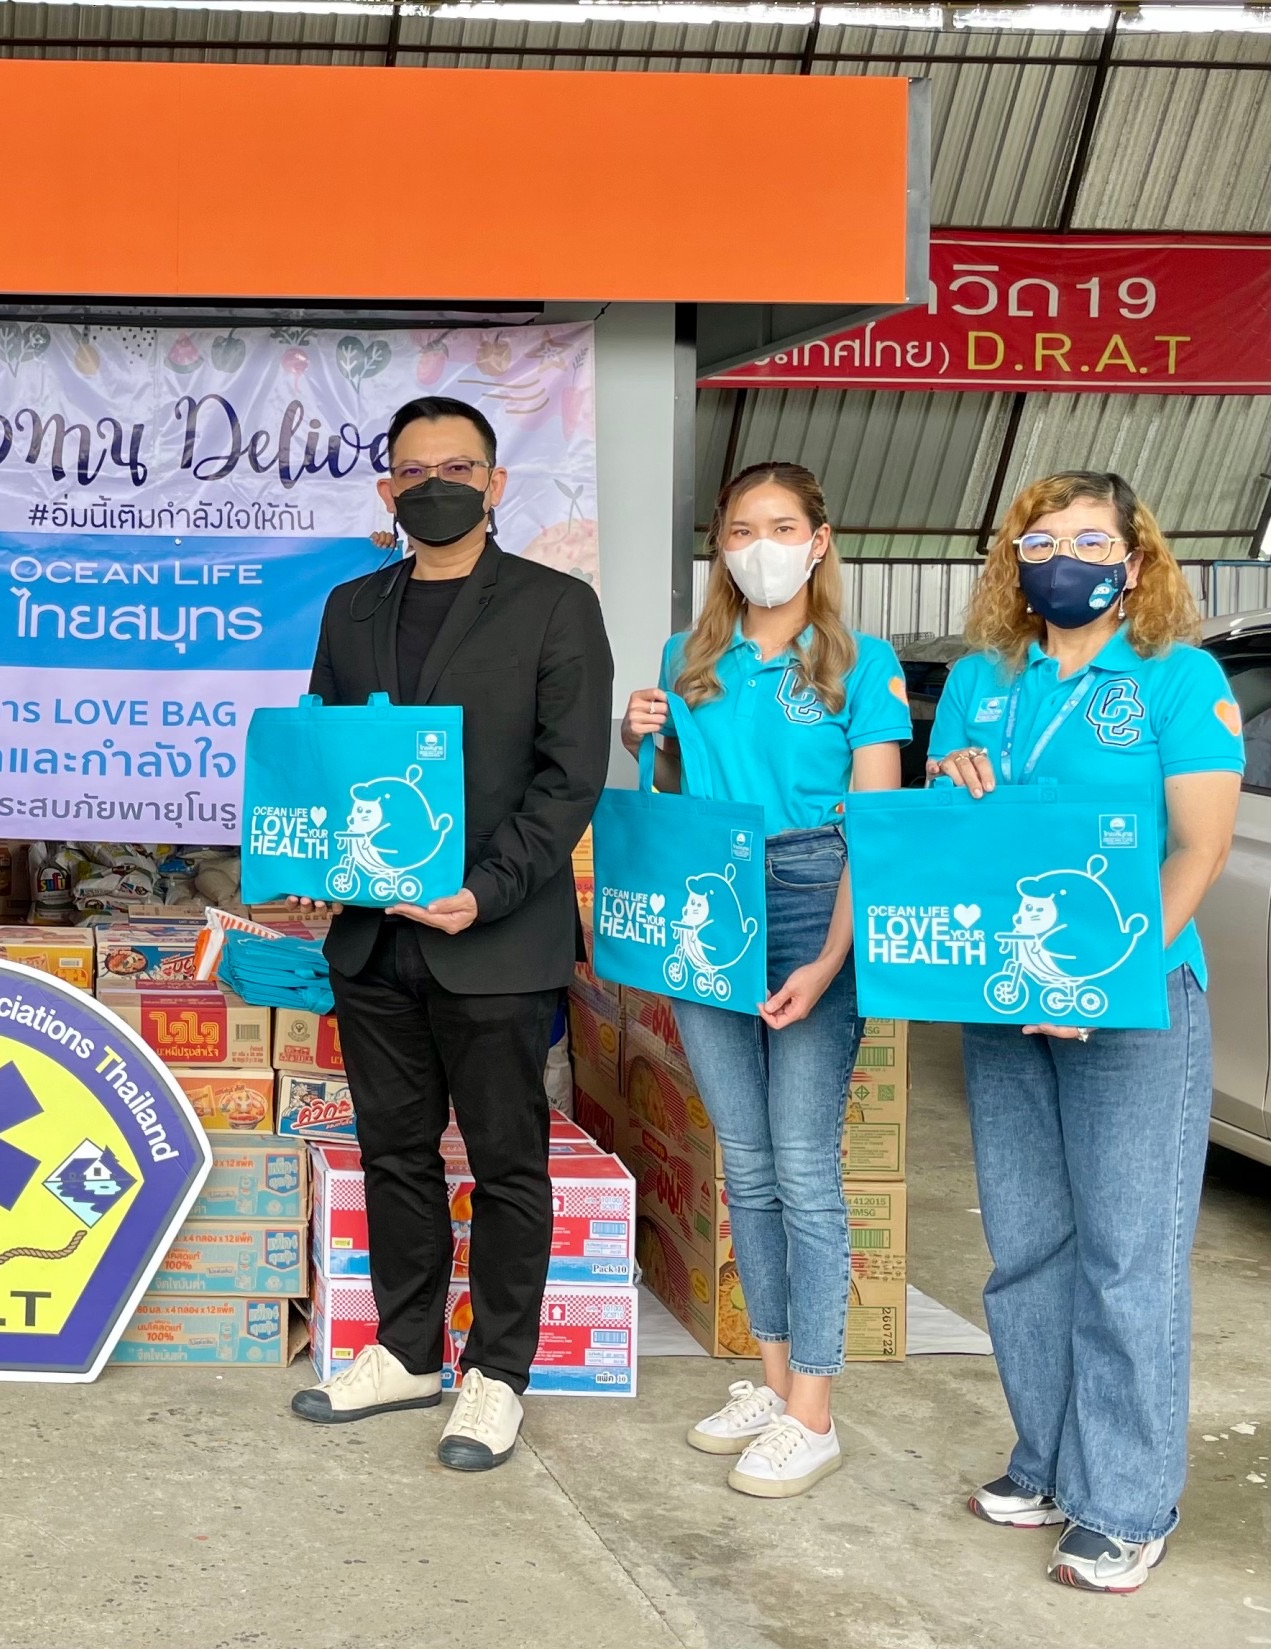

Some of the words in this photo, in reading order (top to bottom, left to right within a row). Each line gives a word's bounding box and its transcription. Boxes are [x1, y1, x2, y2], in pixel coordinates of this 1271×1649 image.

[1075, 276, 1157, 320] 19
[968, 330, 1191, 375] D.R.A.T
[175, 393, 392, 490] Delive
[10, 587, 264, 655] ไทยสมุทร
[53, 698, 149, 727] LOVE
[162, 701, 237, 728] BAG
[253, 806, 287, 817] OCEAN
[289, 808, 308, 818] LIFE
[251, 816, 308, 838] LOVE
[307, 828, 328, 839] YOUR
[250, 834, 329, 860] HEALTH
[602, 886, 629, 900] OCEAN
[630, 891, 649, 905] LIFE
[601, 896, 648, 923] LOVE
[646, 913, 666, 927] YOUR
[867, 905, 916, 917] OCEAN
[919, 906, 950, 919] LIFE
[599, 915, 666, 948] HEALTH
[868, 916, 951, 941] LOVE
[950, 929, 985, 941] YOUR
[868, 939, 987, 966] HEALTH
[148, 1011, 220, 1044] ไวไว
[95, 1046, 179, 1162] Thailand
[849, 1208, 876, 1217] MMSG
[854, 1197, 886, 1205] 412015
[593, 1264, 614, 1273] Pack
[617, 1265, 627, 1273] 10
[147, 1333, 174, 1341] 100%
[881, 1307, 894, 1355] 260722
